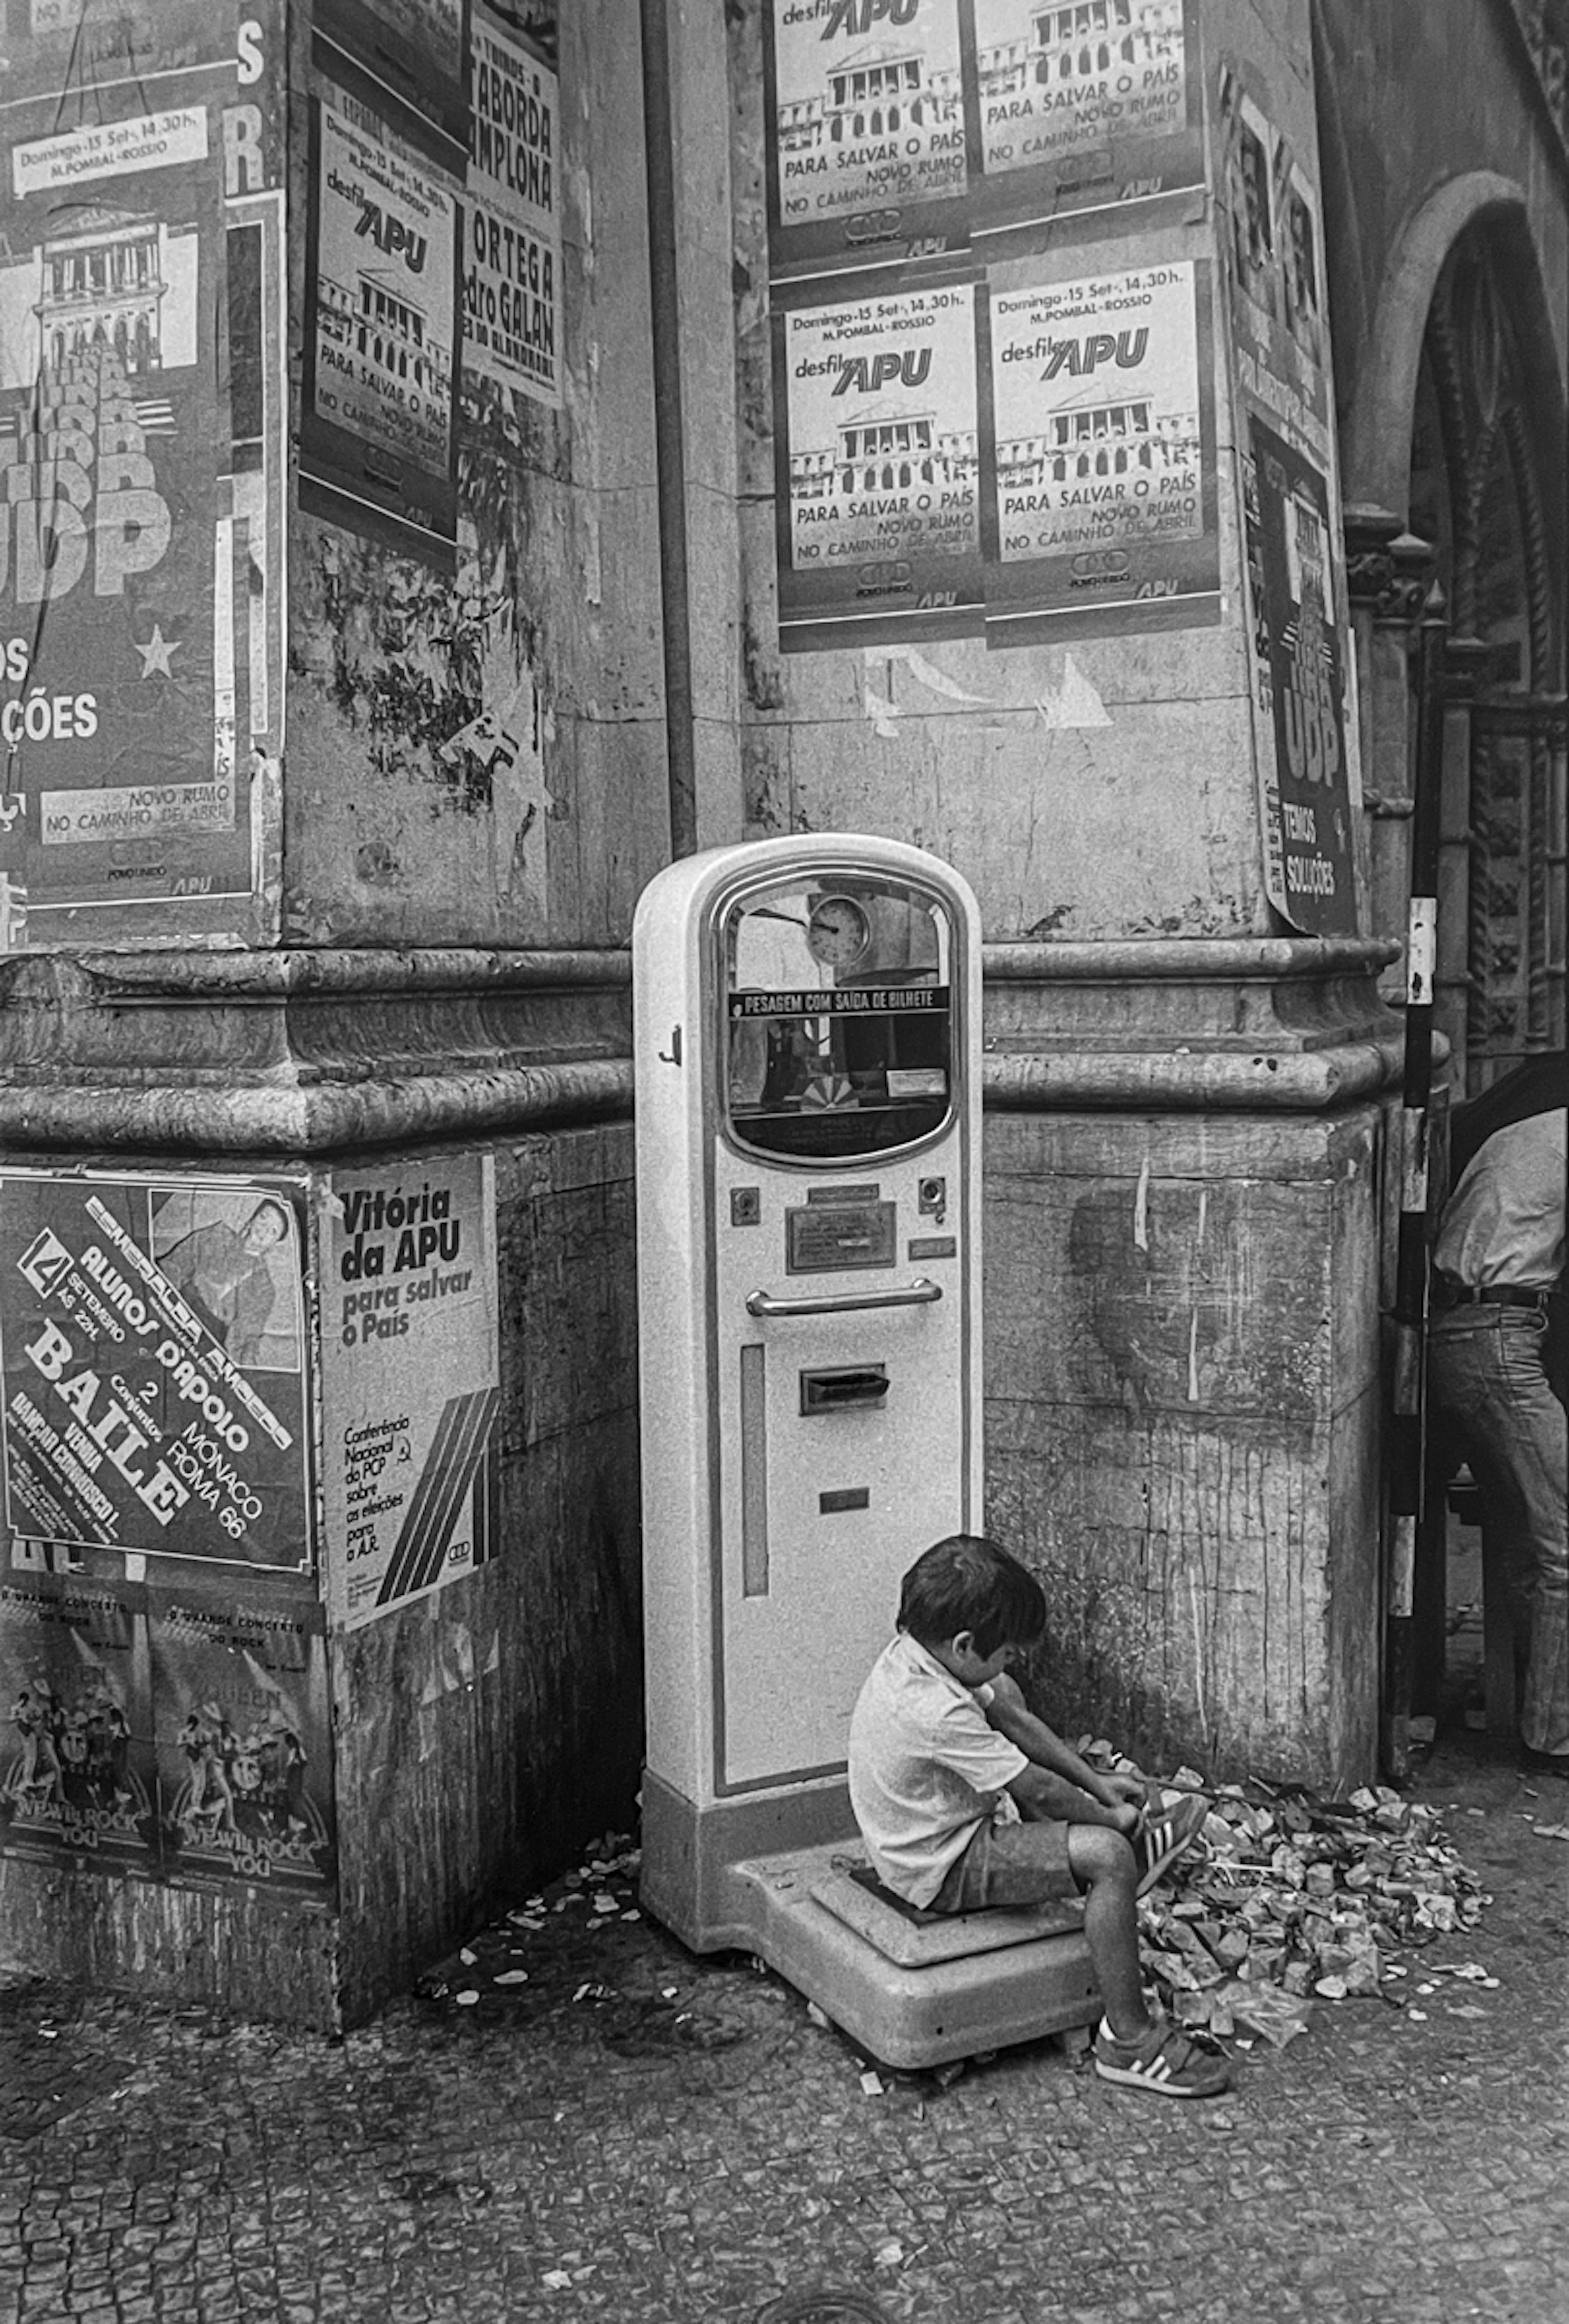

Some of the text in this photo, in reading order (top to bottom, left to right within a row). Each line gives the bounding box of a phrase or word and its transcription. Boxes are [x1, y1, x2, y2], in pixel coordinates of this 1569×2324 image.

[988, 60, 1179, 124] PARA SALVAR O PAÍS
[785, 125, 964, 179] PARA SALVAR O PAÍS
[989, 125, 1097, 162] NO CAMINHO
[867, 155, 963, 184] NOVO RUMO
[785, 198, 809, 214] NO
[817, 184, 887, 208] CAMINHO
[1121, 176, 1163, 199] APU
[355, 199, 428, 273] APU
[908, 236, 948, 257] APU
[474, 210, 552, 301] ORTEGA
[499, 280, 554, 356] GALAN
[1040, 327, 1149, 382] APU
[321, 344, 354, 378] PARA
[361, 371, 406, 406] SALVAR
[410, 395, 420, 413] O
[831, 348, 932, 397] APU
[798, 484, 974, 524] PARA SALVAR O PAÍS
[1005, 470, 1196, 515] PARA SALVAR O PAÍS
[877, 512, 974, 536] NOVO RUMO
[1092, 498, 1196, 524] NOVO RUMO
[798, 544, 820, 560] NO
[828, 536, 899, 556] CAMINHO
[1006, 536, 1030, 551] NO
[1038, 525, 1114, 547] CAMINHO
[918, 591, 958, 609] APU
[1135, 579, 1179, 600] APU
[2, 687, 98, 753] ÇÕES
[130, 785, 230, 809] NOVO RUMO
[47, 815, 70, 832] NO
[78, 809, 152, 829] CAMINHO
[172, 875, 212, 895] APU
[744, 990, 933, 1014] PESAGEM COM SAÍDA DE BILHETE
[339, 1183, 450, 1234] Vitória
[342, 1219, 460, 1281] da APU
[67, 1271, 125, 1344] SETEMBRO
[80, 1246, 161, 1336] ALUNOS
[343, 1268, 472, 1325] para salvar
[342, 1308, 409, 1346] o País
[111, 1374, 163, 1443] Conjuntos
[139, 1382, 159, 1405] 2
[25, 1317, 191, 1526] BAILE
[65, 1422, 104, 1474] VENHA
[345, 1456, 385, 1485] do PCP
[166, 1440, 247, 1539] ROMA 66
[347, 1523, 374, 1547] para
[232, 1636, 265, 1648] ROCK
[61, 1824, 98, 1848] YOU
[83, 1808, 141, 1833] ROCK
[229, 1853, 270, 1878] YOU
[254, 1836, 319, 1864] ROCK
